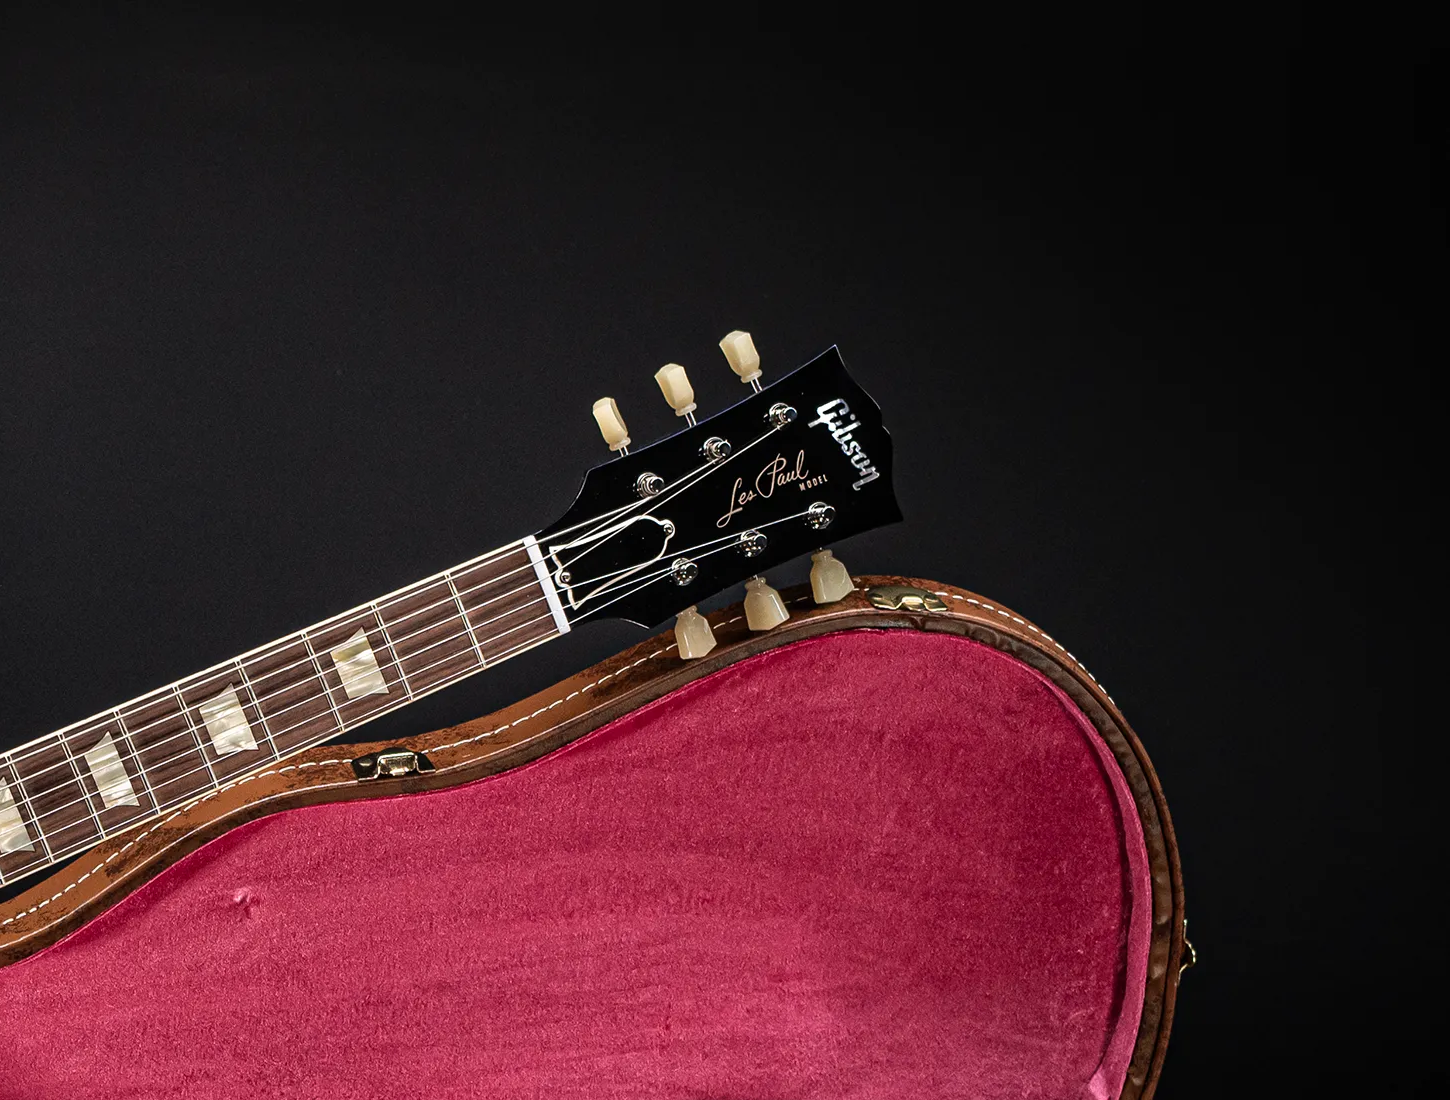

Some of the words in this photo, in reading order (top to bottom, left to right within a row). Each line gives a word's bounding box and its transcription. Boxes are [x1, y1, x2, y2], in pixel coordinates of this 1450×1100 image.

[799, 474, 828, 491] MODEL
[808, 399, 879, 491] Gibson
[717, 478, 756, 528] Les
[756, 450, 809, 498] Paul
